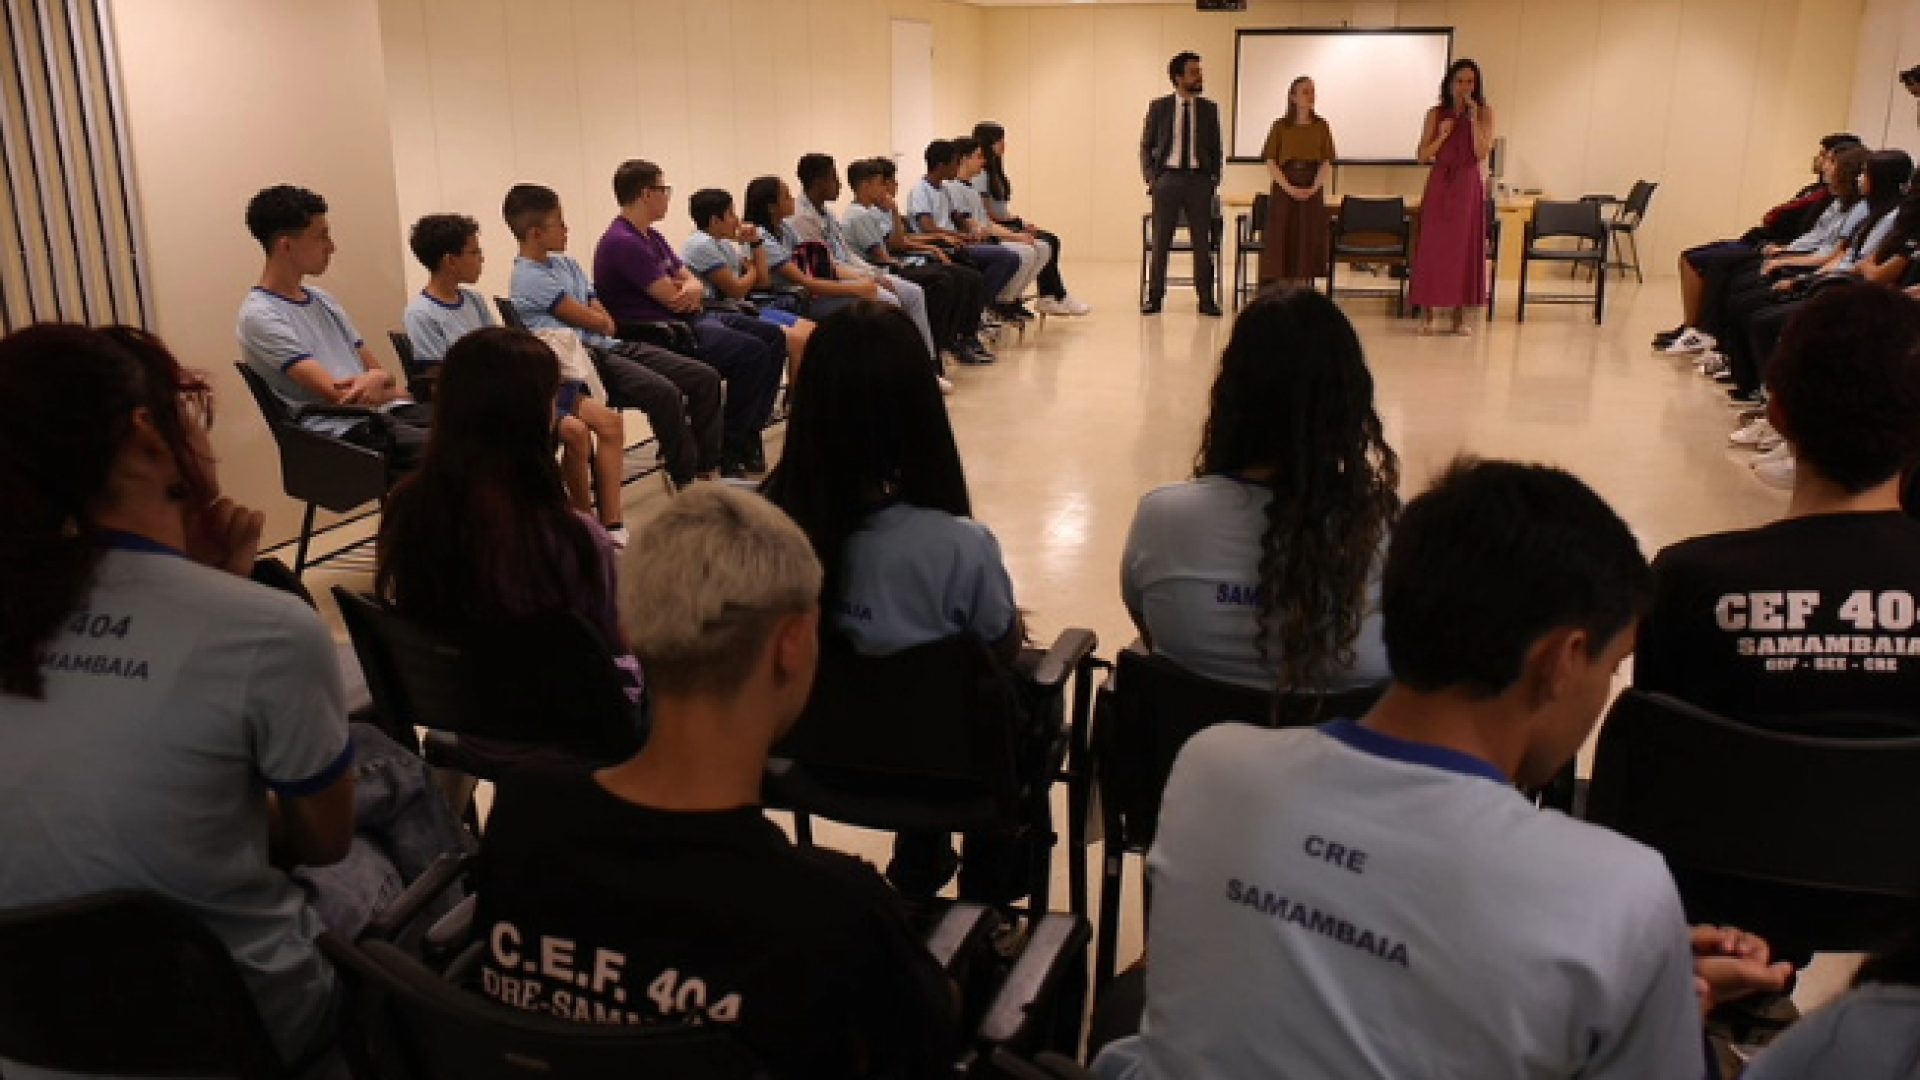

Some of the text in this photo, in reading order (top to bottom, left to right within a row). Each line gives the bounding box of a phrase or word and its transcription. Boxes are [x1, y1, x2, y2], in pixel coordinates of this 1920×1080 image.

[1715, 590, 1920, 631] CEF 40
[1736, 636, 1920, 655] SAMAMBAIA
[1303, 835, 1368, 873] CRE
[1226, 878, 1411, 968] SAMAMBAIA
[490, 920, 743, 1022] C.E.F. 404
